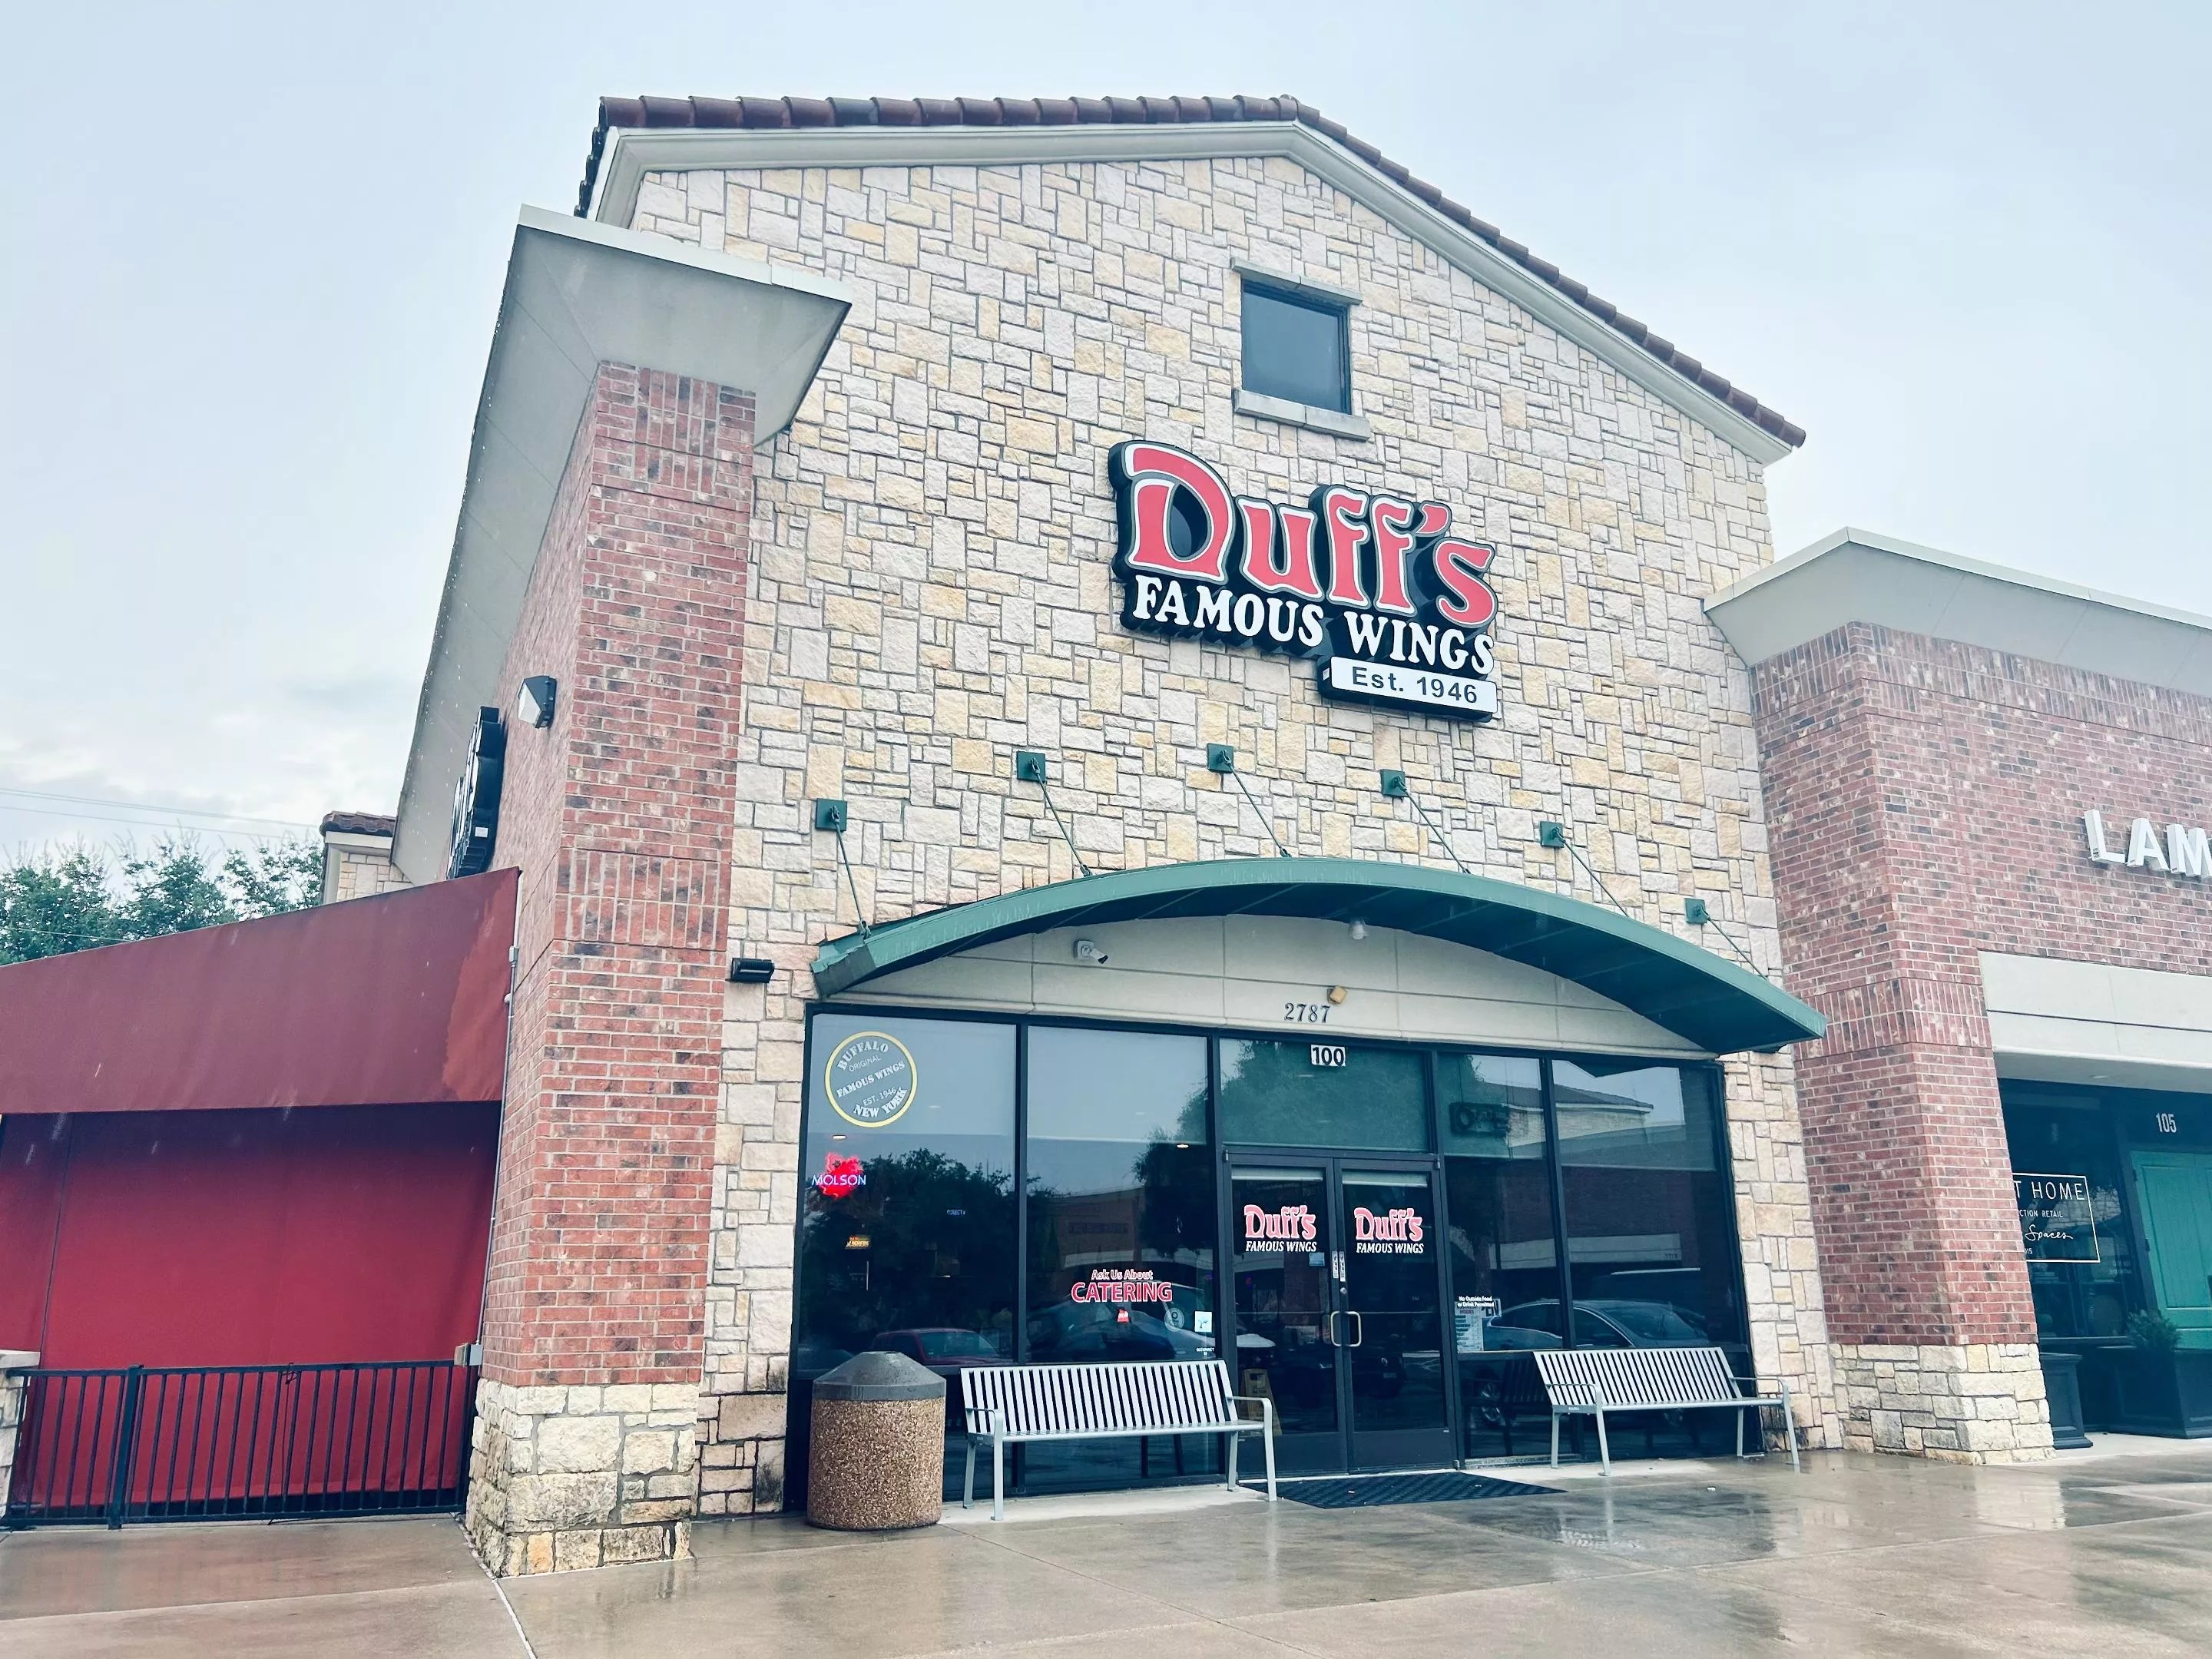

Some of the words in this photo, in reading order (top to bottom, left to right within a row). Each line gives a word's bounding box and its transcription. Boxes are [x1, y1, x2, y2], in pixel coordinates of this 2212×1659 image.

[1124, 442, 1497, 627] Duff's
[1133, 575, 1324, 647] FAMOUS
[1344, 612, 1495, 675] WINGS
[1353, 666, 1404, 692] Est.
[1417, 676, 1478, 704] 1946
[1284, 1002, 1331, 1024] 2787
[837, 1041, 889, 1070] BUFFALO
[849, 1055, 882, 1071] ORIGINAL
[1312, 1046, 1345, 1066] 100
[836, 1075, 875, 1098] FAMOUS
[875, 1061, 906, 1080] WINGS
[853, 1104, 879, 1118] NEW
[881, 1087, 907, 1114] YORK
[863, 1095, 879, 1106] EST.
[879, 1087, 896, 1100] 1946
[2156, 1113, 2177, 1134] 105
[812, 1174, 866, 1186] MOLSON
[2032, 1181, 2085, 1200] HOME
[1243, 1204, 1316, 1240] Duff's
[1354, 1207, 1423, 1242] Duff's
[2025, 1224, 2074, 1241] Spaces
[1246, 1240, 1285, 1252] FAMOUS
[1286, 1241, 1317, 1252] WINGS
[1356, 1243, 1392, 1253] FAMOUS
[1394, 1243, 1424, 1253] WINGS
[1091, 1269, 1110, 1280] Ask
[1110, 1269, 1122, 1280] Us
[1124, 1269, 1153, 1280] About
[1071, 1282, 1173, 1303] CATERING
